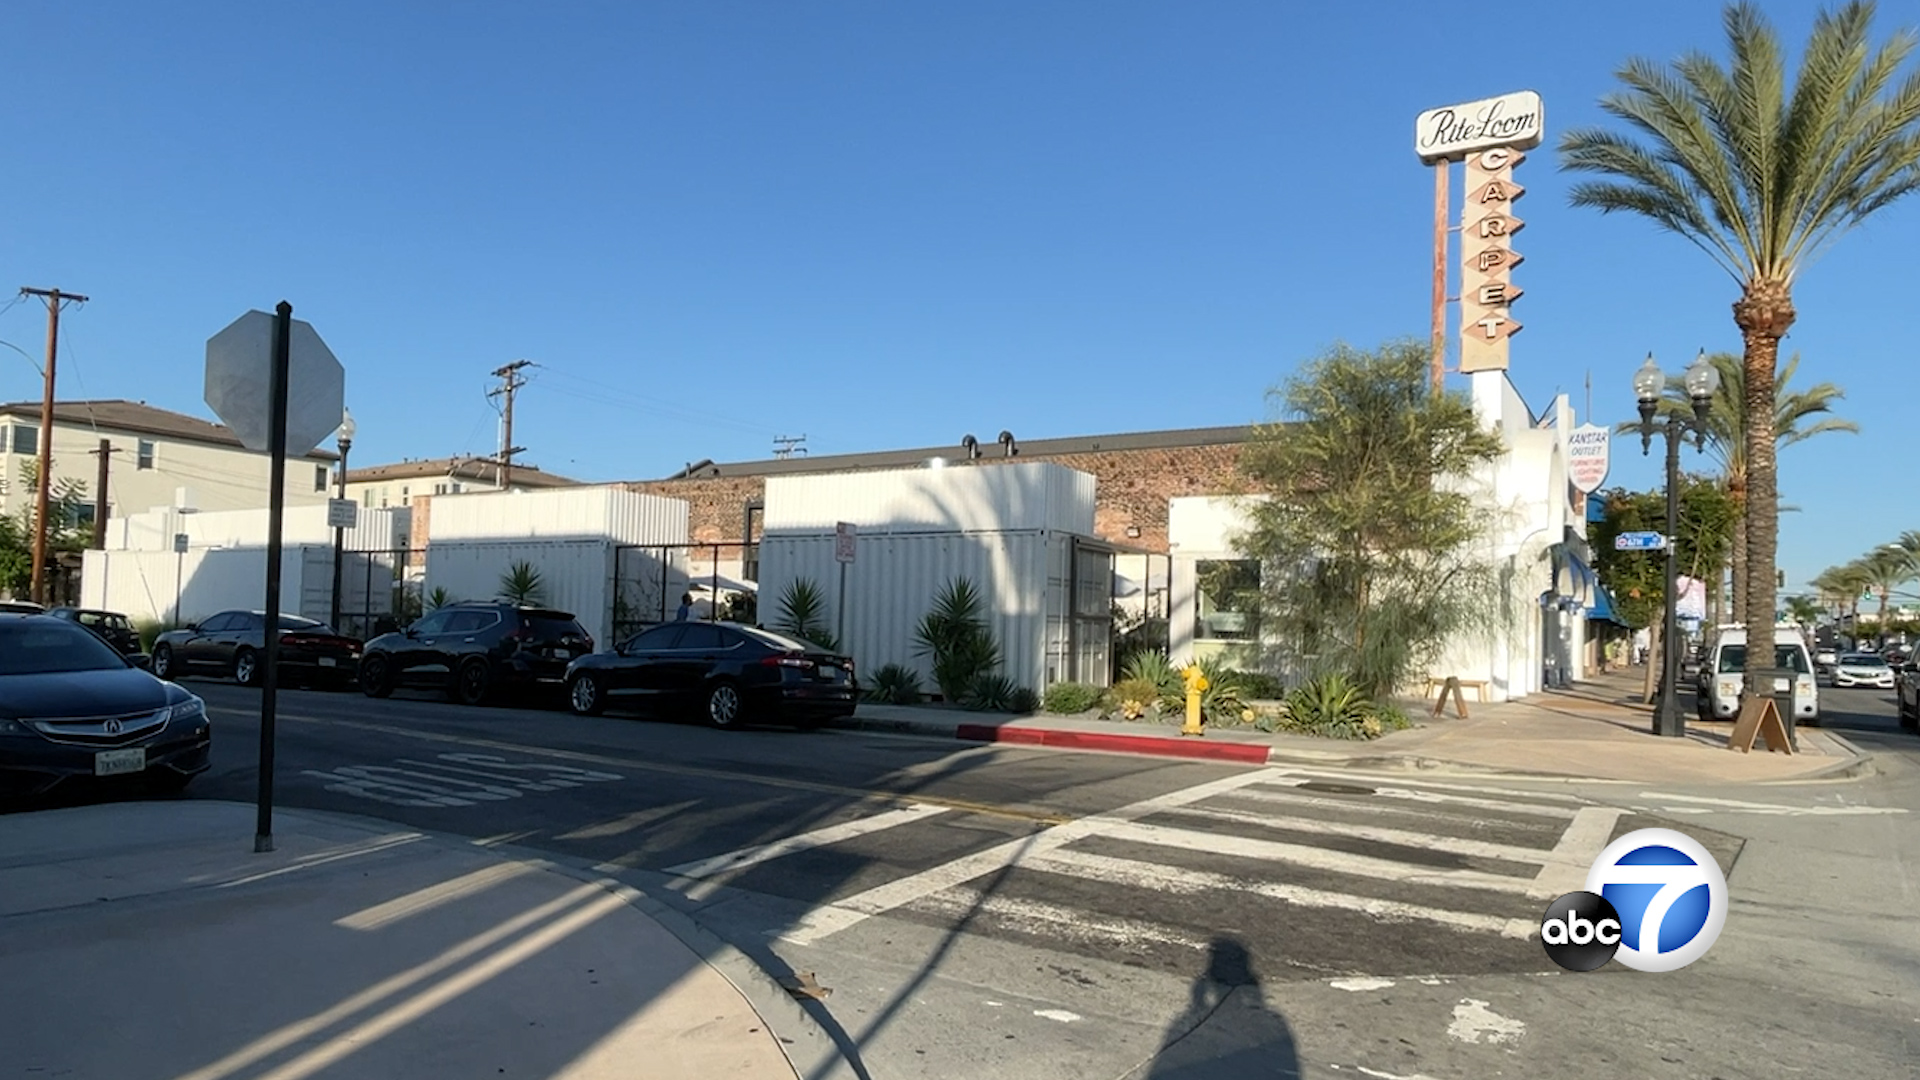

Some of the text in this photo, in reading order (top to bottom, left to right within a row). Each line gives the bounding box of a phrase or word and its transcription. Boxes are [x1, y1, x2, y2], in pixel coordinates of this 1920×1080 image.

[1421, 100, 1536, 148] Rite-Loom
[1477, 147, 1508, 339] CARPET
[1568, 432, 1608, 444] KANSTAR
[1571, 446, 1602, 456] OUTLET
